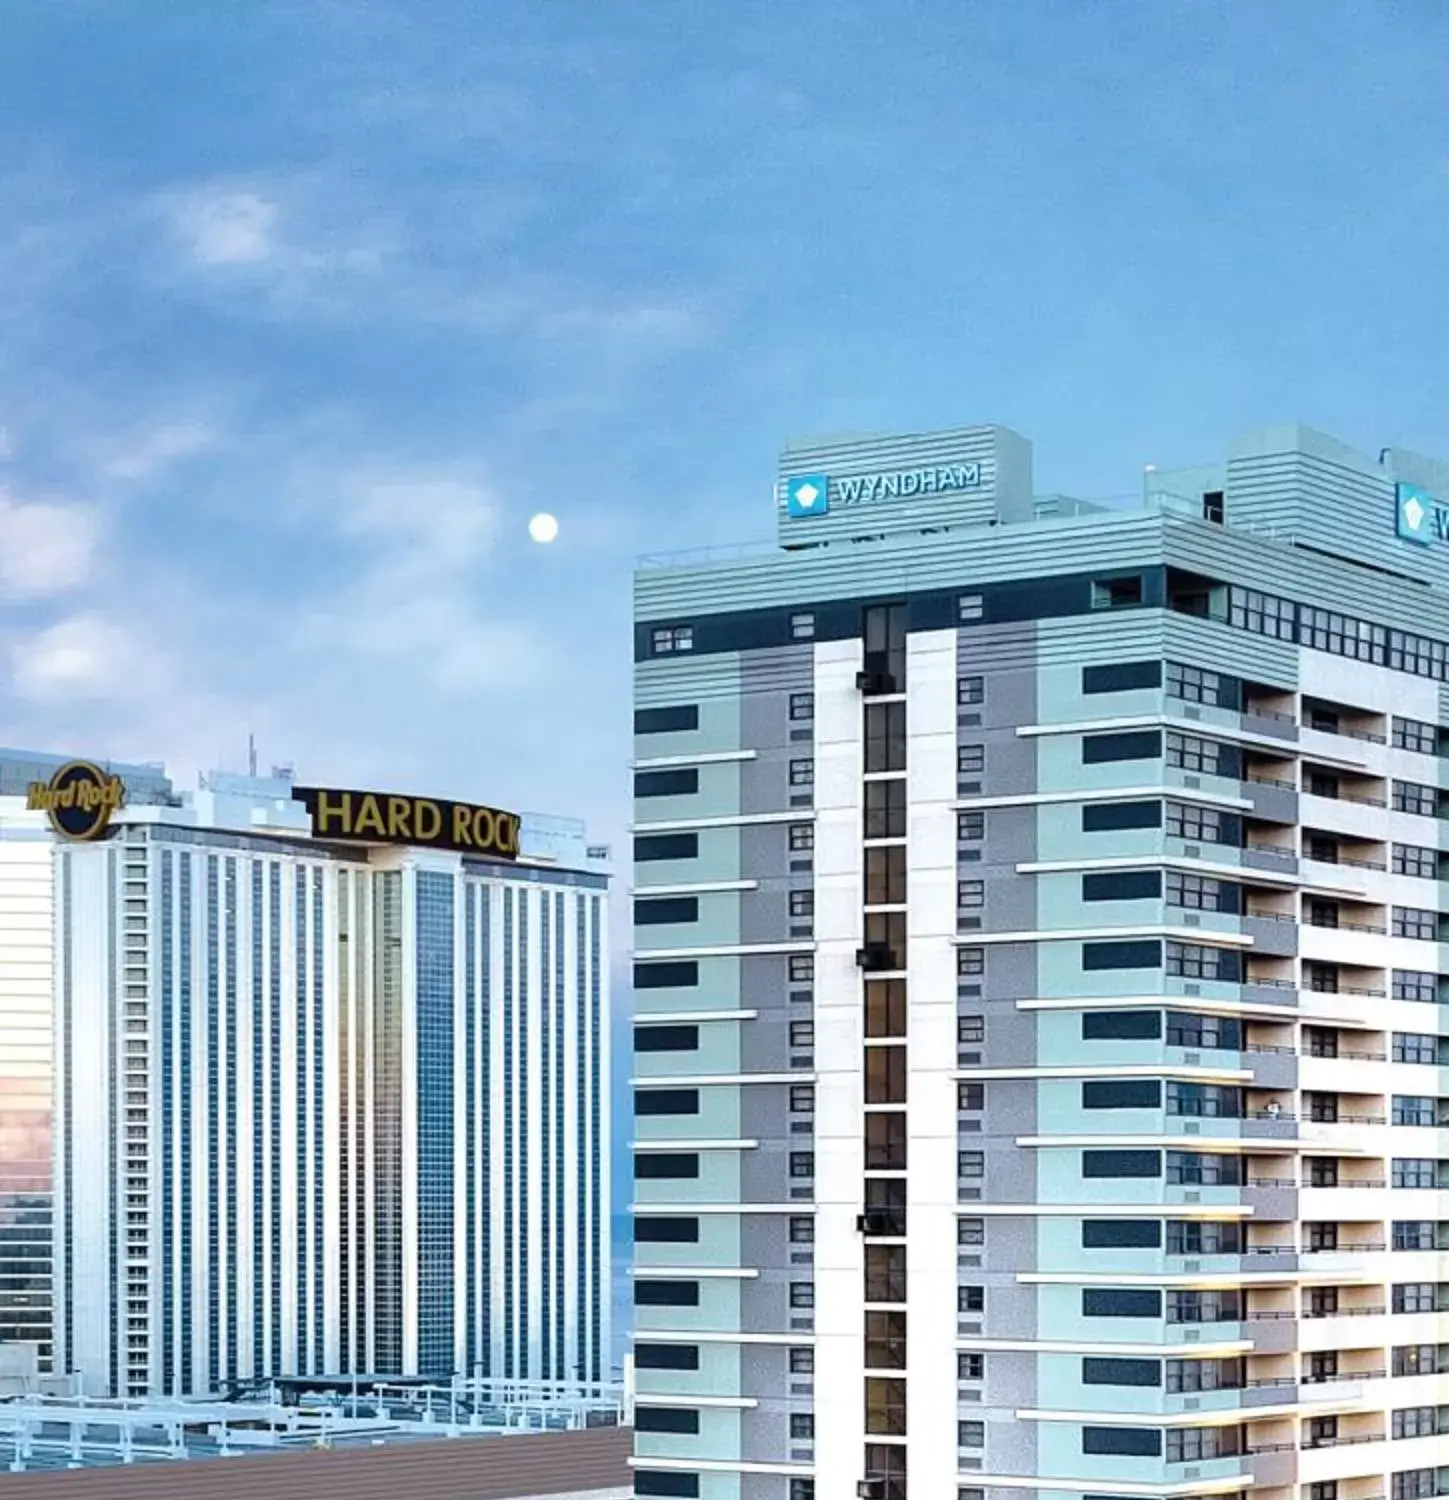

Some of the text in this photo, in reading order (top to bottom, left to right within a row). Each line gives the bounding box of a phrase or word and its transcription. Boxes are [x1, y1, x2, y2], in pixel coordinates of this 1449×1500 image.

[836, 463, 981, 503] WYNDHAM
[316, 790, 520, 853] HARD ROCK
